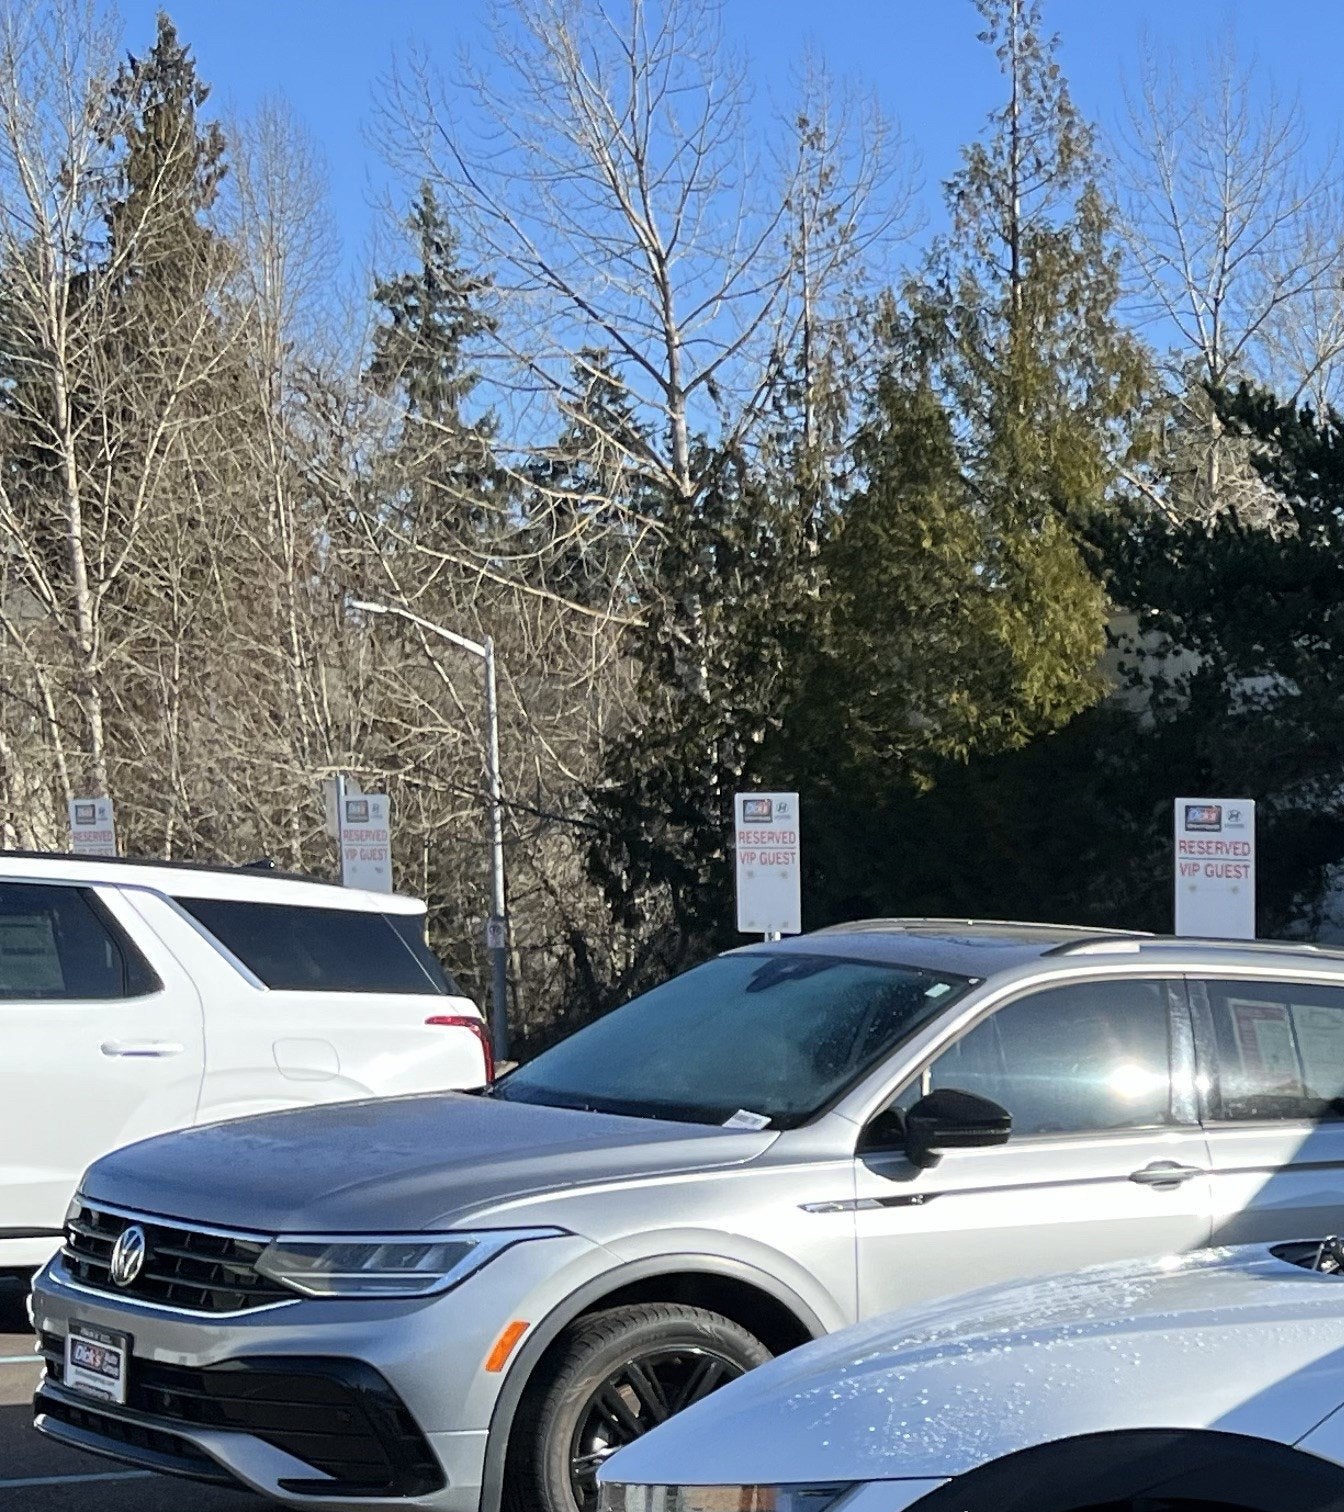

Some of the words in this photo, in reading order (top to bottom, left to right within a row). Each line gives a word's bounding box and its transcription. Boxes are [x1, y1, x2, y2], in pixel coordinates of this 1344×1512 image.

[738, 831, 797, 845] RESERVED
[1179, 840, 1251, 857] RESERVED
[740, 852, 757, 865] VIP
[760, 852, 797, 866] GUEST
[1179, 862, 1200, 876] VIP
[1204, 863, 1250, 879] GUEST
